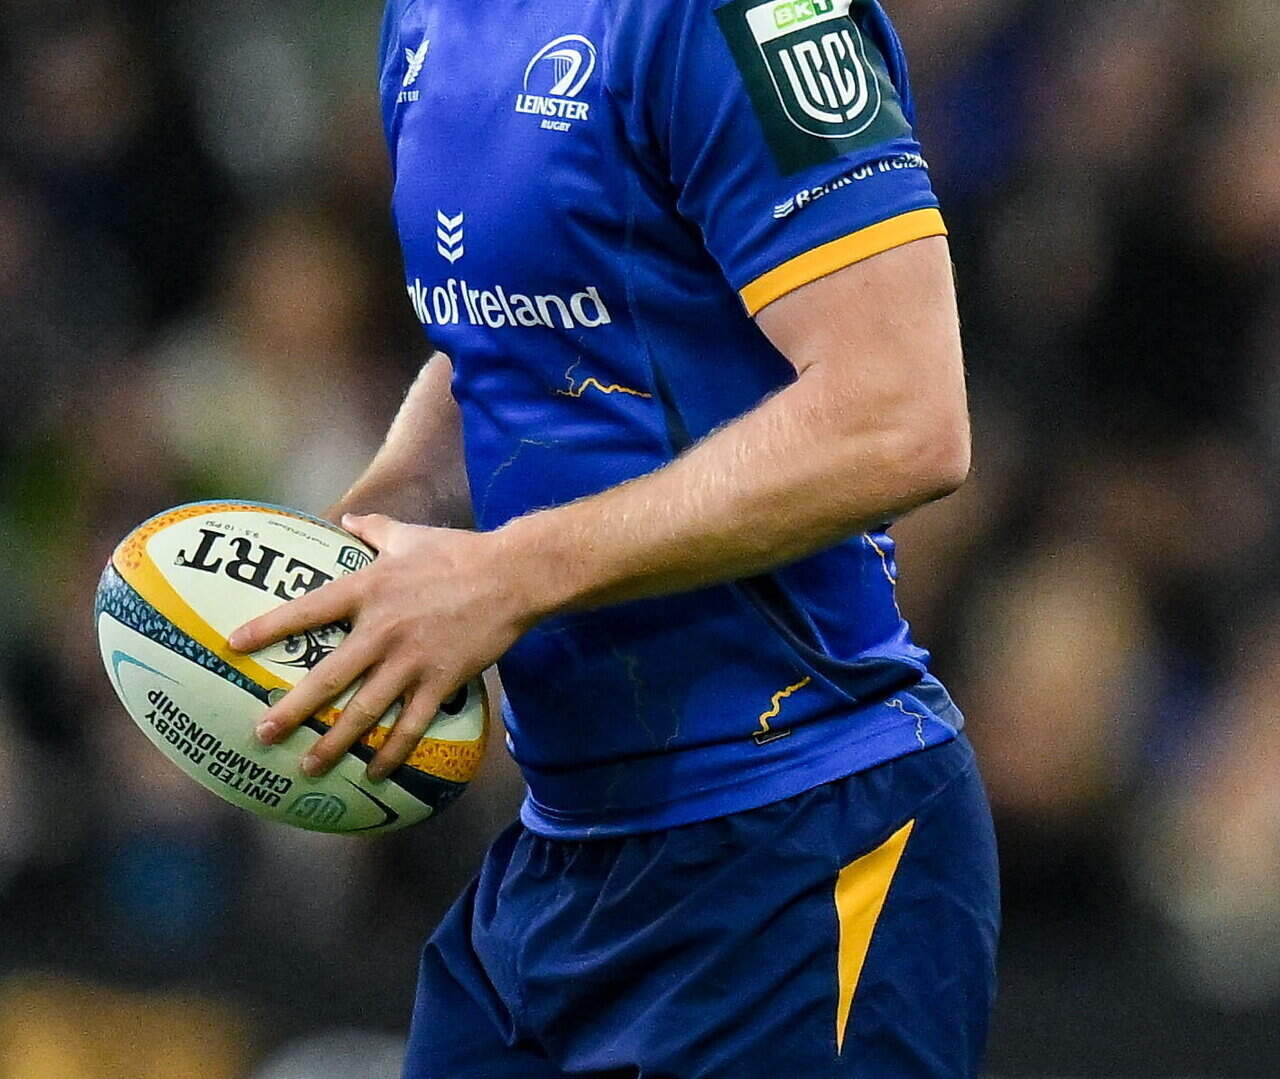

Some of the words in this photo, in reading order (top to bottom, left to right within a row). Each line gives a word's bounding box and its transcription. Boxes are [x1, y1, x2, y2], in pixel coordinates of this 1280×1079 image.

[515, 94, 589, 120] LEINSTER
[540, 119, 571, 132] RUGBY
[432, 278, 460, 325] of
[460, 279, 612, 329] Ireland
[144, 709, 207, 766] RUGBY
[147, 689, 294, 795] CHAMPIONSHIP
[207, 762, 282, 808] UNITED
